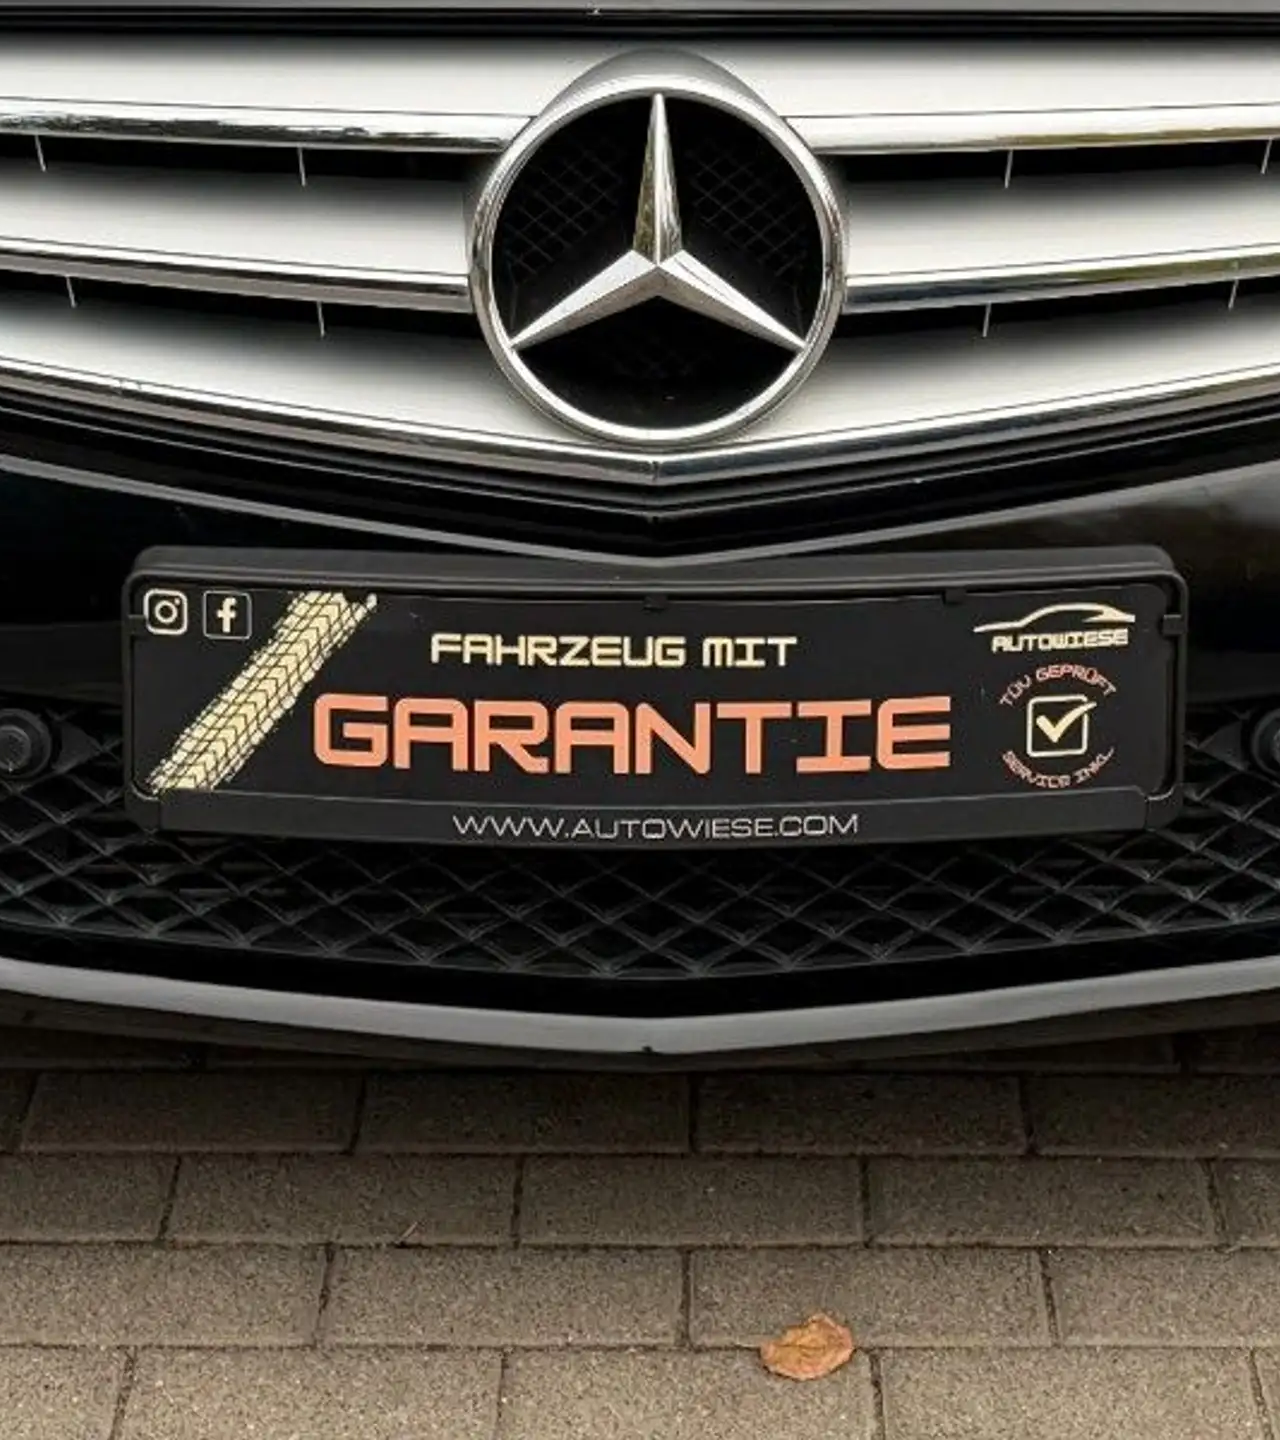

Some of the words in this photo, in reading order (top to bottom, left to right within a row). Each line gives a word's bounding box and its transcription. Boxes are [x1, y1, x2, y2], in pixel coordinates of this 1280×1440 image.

[430, 632, 687, 668] FAHRZEUG
[701, 635, 799, 668] MIT
[991, 627, 1129, 653] AUTOWIESE
[313, 693, 952, 775] GARANTIE
[451, 813, 860, 840] WWW.AUTOWIESE.COM
